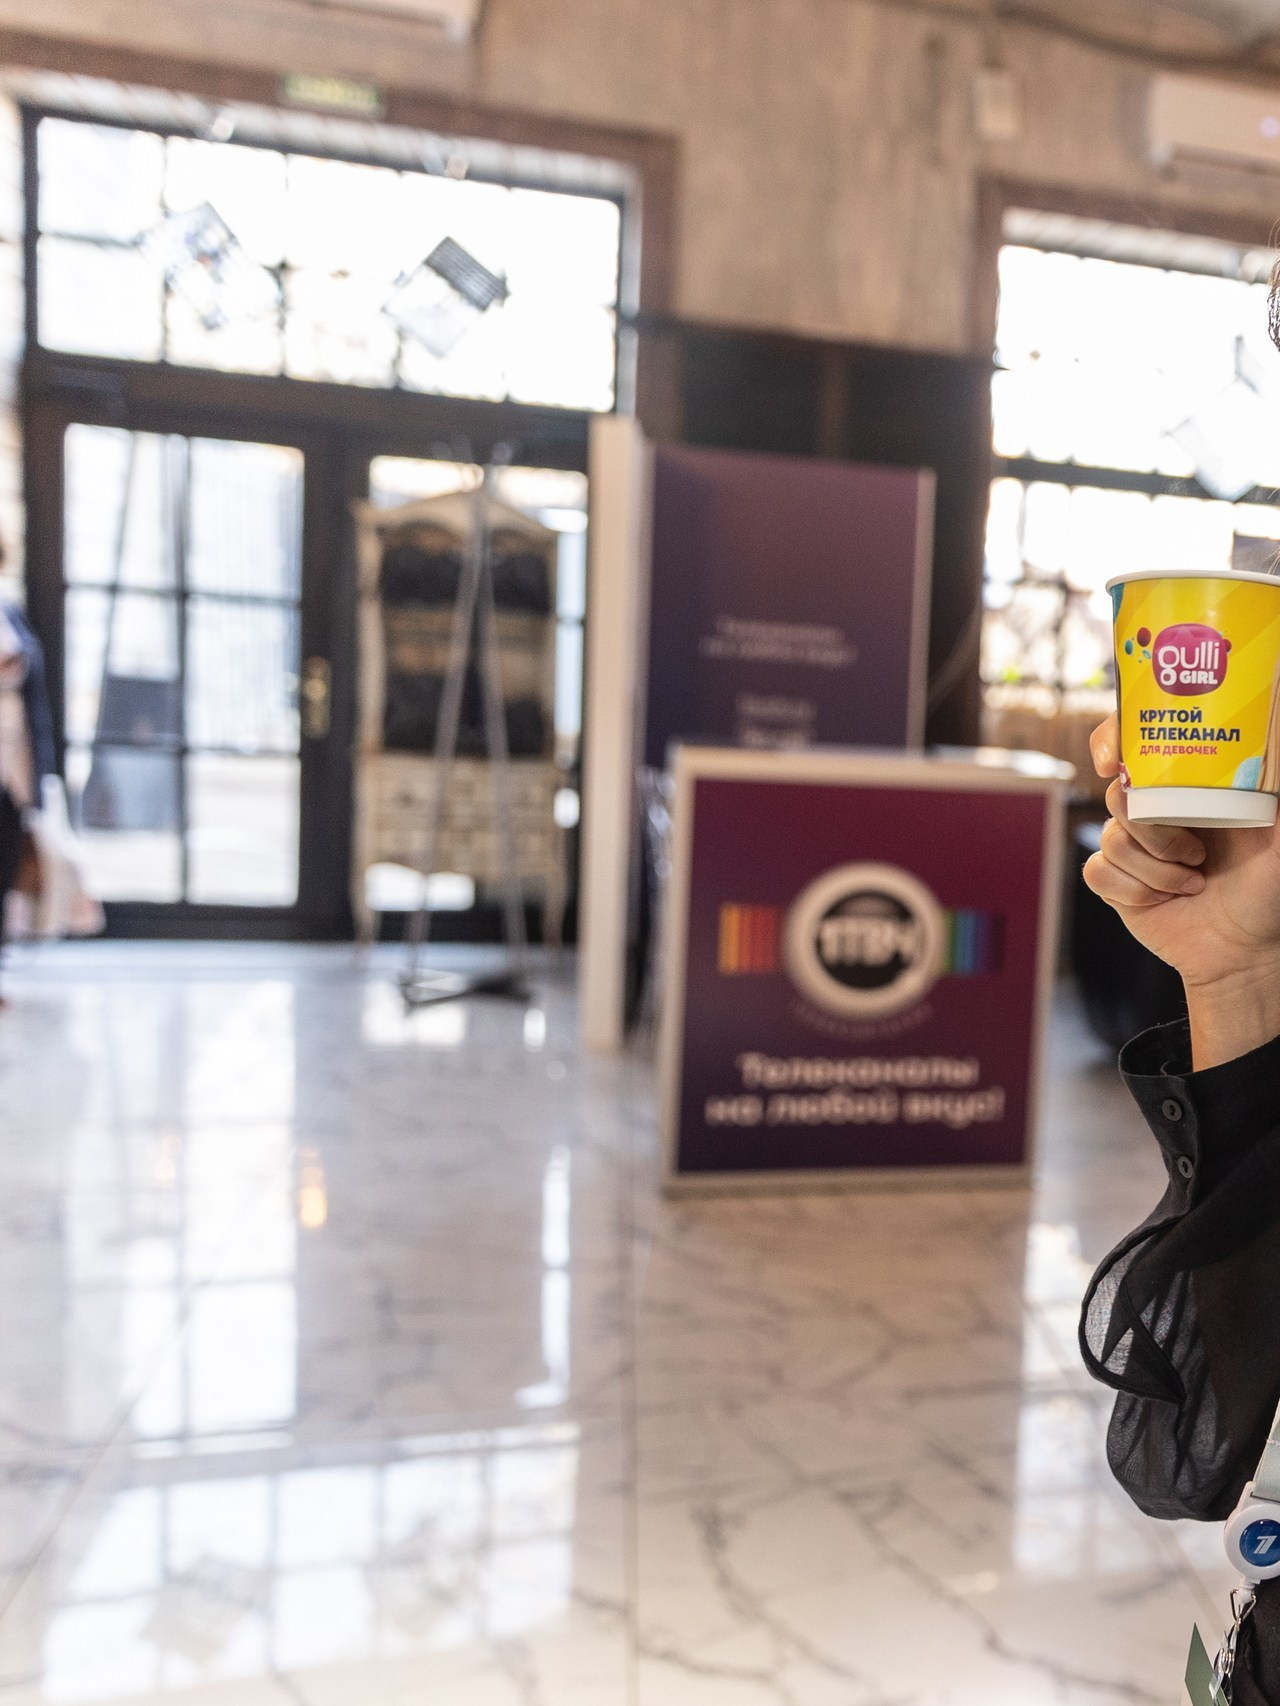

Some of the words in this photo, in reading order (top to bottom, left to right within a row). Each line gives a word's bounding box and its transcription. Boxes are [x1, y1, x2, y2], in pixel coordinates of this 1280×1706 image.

[1158, 641, 1219, 686] gulli
[1180, 671, 1218, 685] GIRL
[1140, 706, 1202, 723] КРУТОЙ
[1140, 727, 1240, 742] ТЕЛЕКАНАЛ
[1140, 745, 1161, 756] ДЛЯ
[1162, 745, 1218, 756] ДЕВОЧЕК
[738, 1053, 978, 1088] Телеканалы
[706, 1096, 762, 1126] на
[766, 1087, 898, 1124] любой
[903, 1088, 1004, 1128] вкус!
